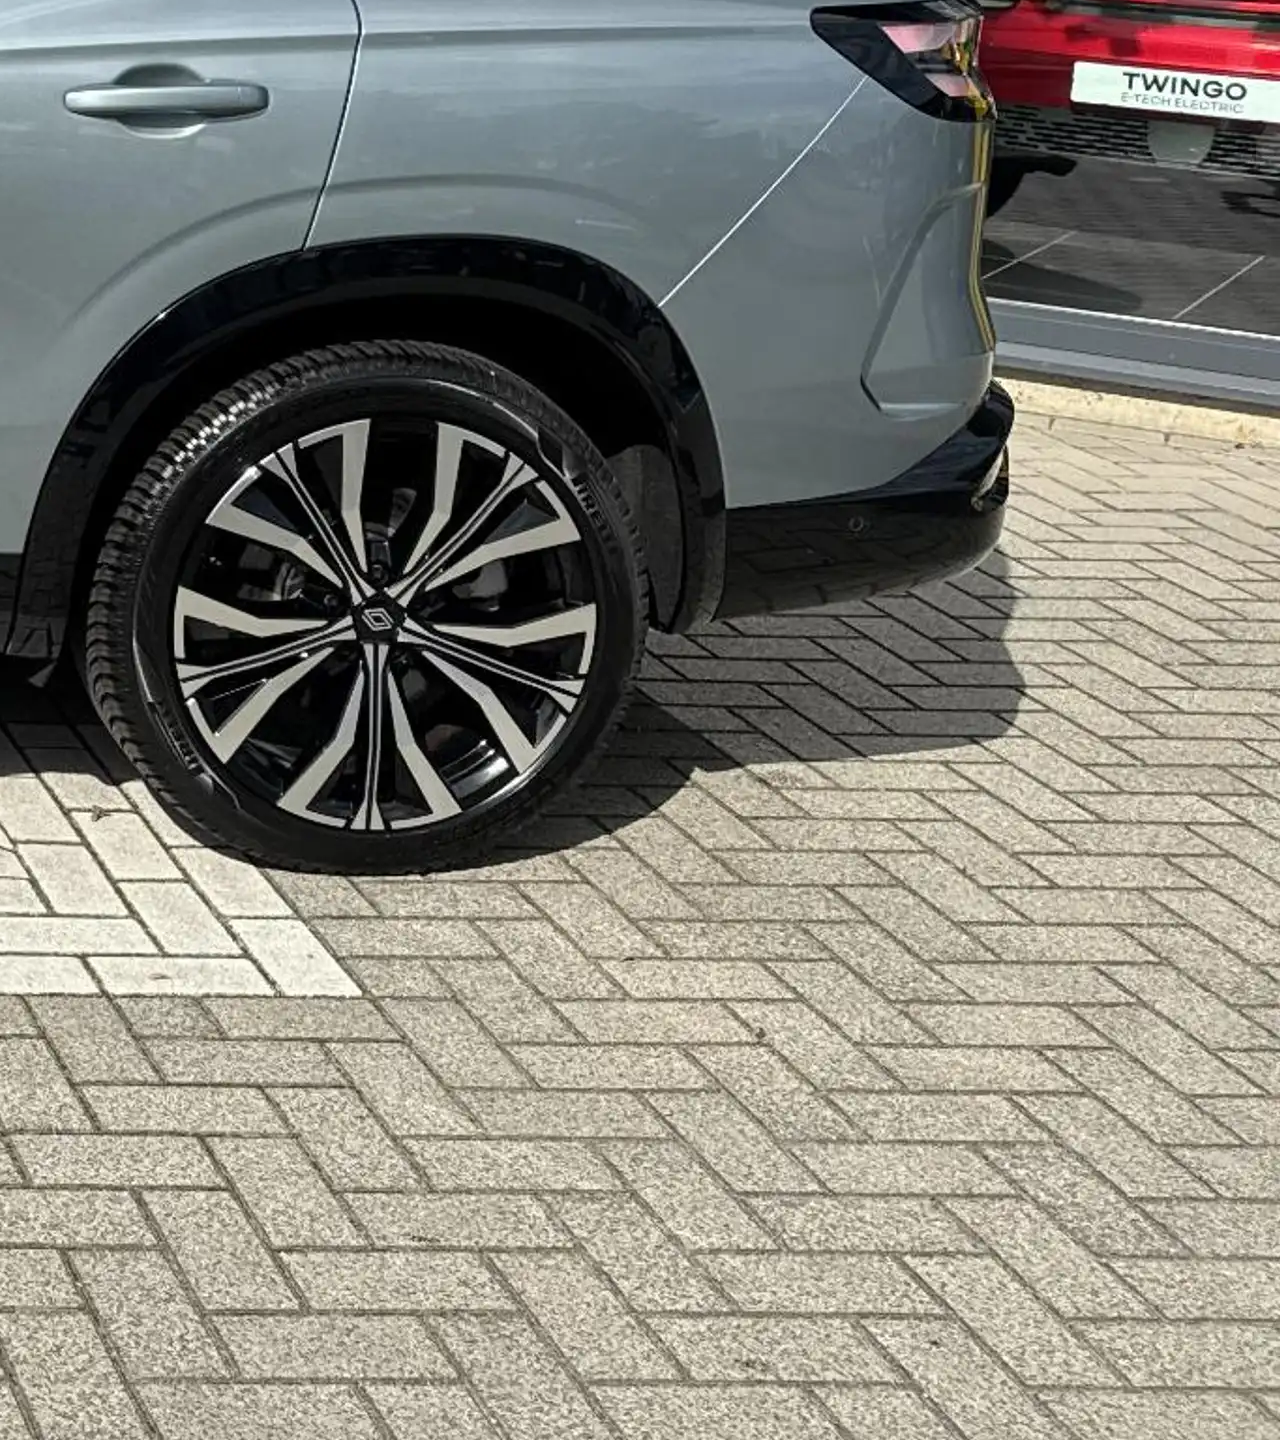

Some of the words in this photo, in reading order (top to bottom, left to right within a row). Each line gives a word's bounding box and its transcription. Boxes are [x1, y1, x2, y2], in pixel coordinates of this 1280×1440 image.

[1122, 72, 1247, 101] TWINGO
[1120, 92, 1171, 107] E-TECH
[1174, 97, 1245, 114] ELECTRIC
